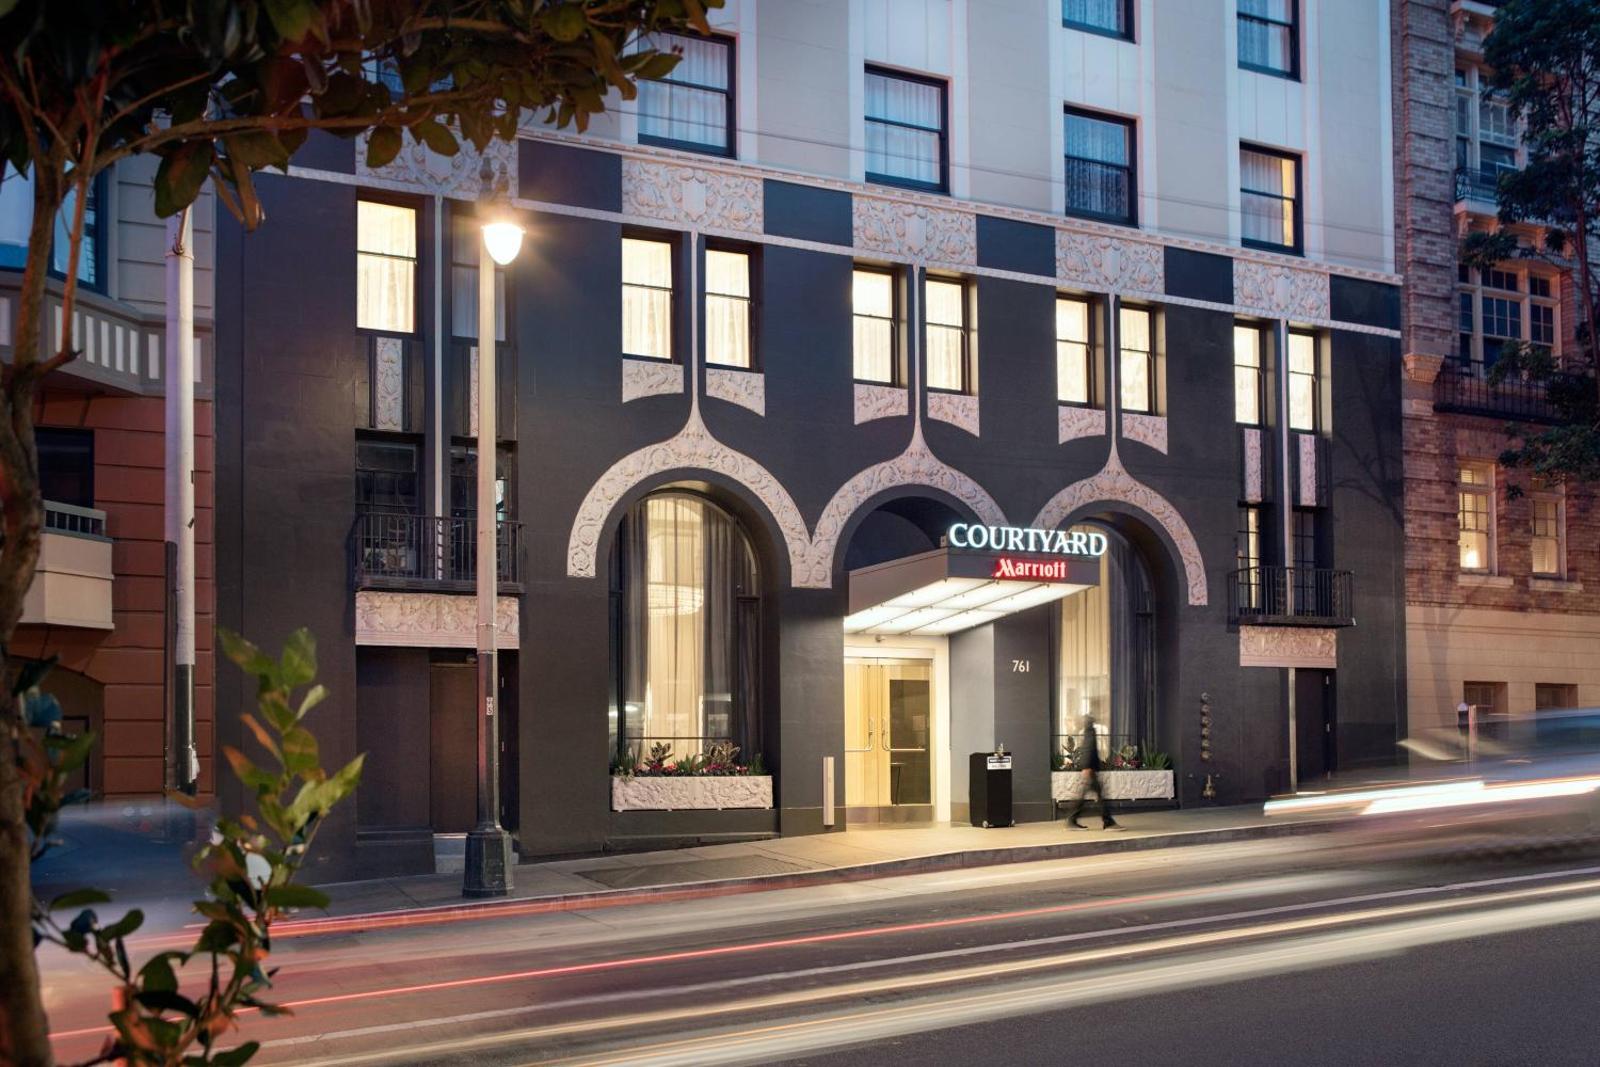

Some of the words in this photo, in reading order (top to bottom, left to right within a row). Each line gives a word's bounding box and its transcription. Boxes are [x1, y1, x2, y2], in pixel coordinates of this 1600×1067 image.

[949, 523, 1108, 556] COURTYARD
[994, 558, 1066, 578] Marriott
[1012, 659, 1030, 673] 761
